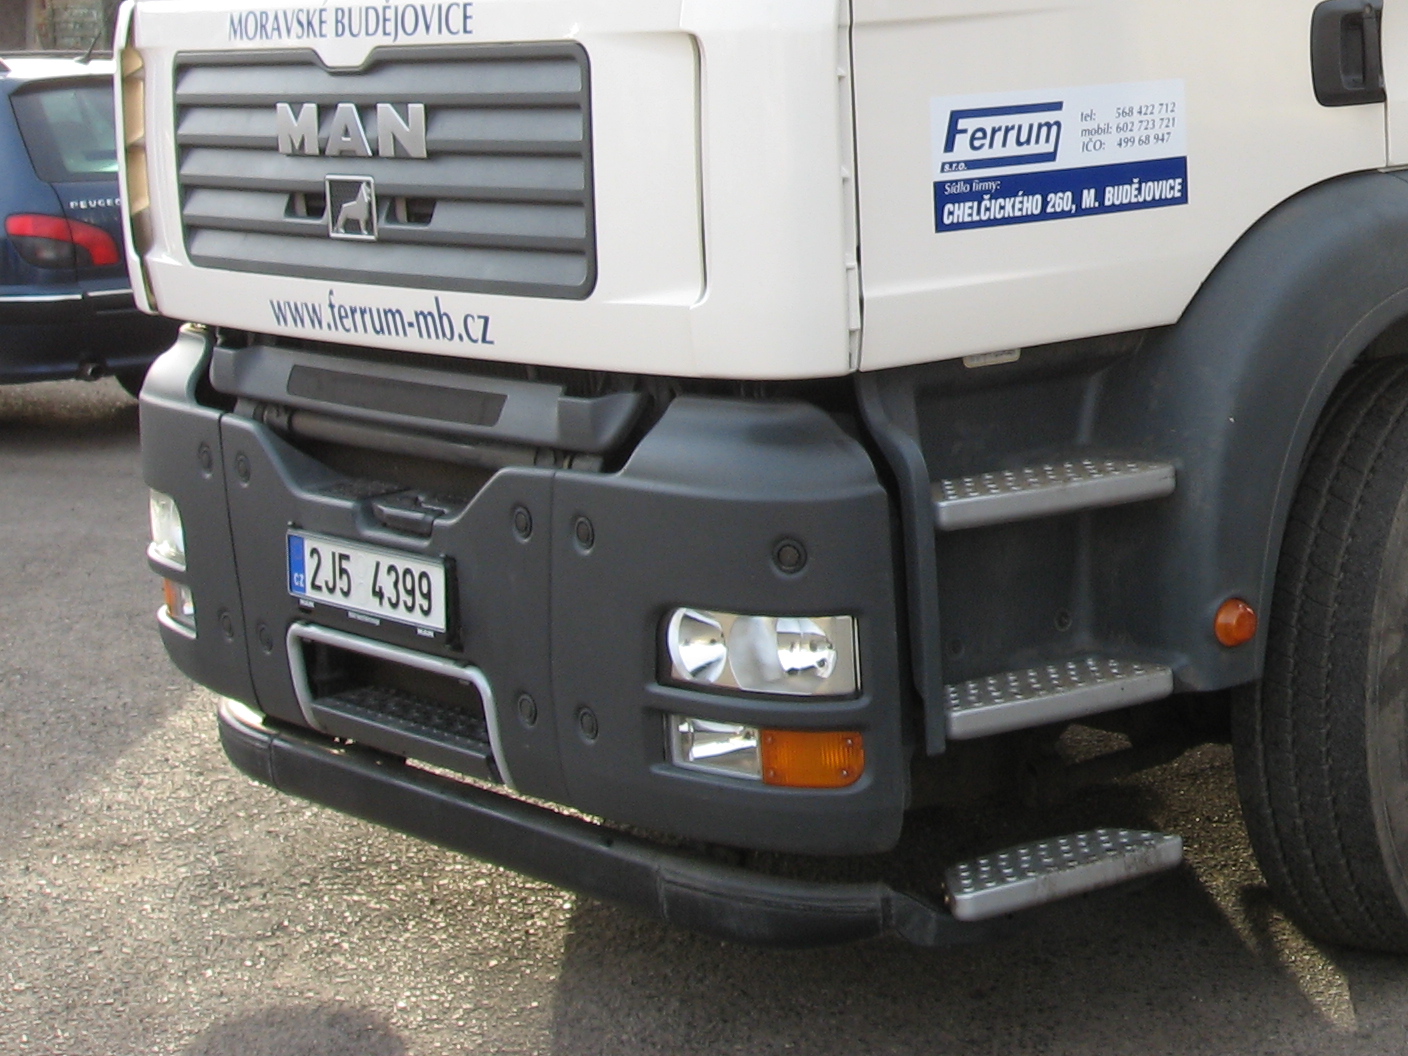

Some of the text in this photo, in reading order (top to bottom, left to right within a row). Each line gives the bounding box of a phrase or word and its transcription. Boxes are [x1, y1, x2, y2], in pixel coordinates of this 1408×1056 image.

[228, 0, 329, 41] MORAVSKÉ
[1080, 102, 1176, 122] tel: 568 422 712
[1081, 117, 1175, 137] mobil: 602 723 721
[276, 102, 428, 160] MAN
[942, 102, 1064, 158] Ferrum
[1081, 131, 1171, 153] IČO: 499 68 947
[943, 162, 968, 173] s.r.o.
[943, 178, 1182, 225] CHELČICKÉHO 260, M. BUDĚJOVICE
[944, 179, 1001, 197] Sídlo firmy:
[268, 289, 495, 345] www.ferrum-mb.cz
[293, 573, 304, 587] CZ
[310, 547, 432, 617] 2J5 4399
